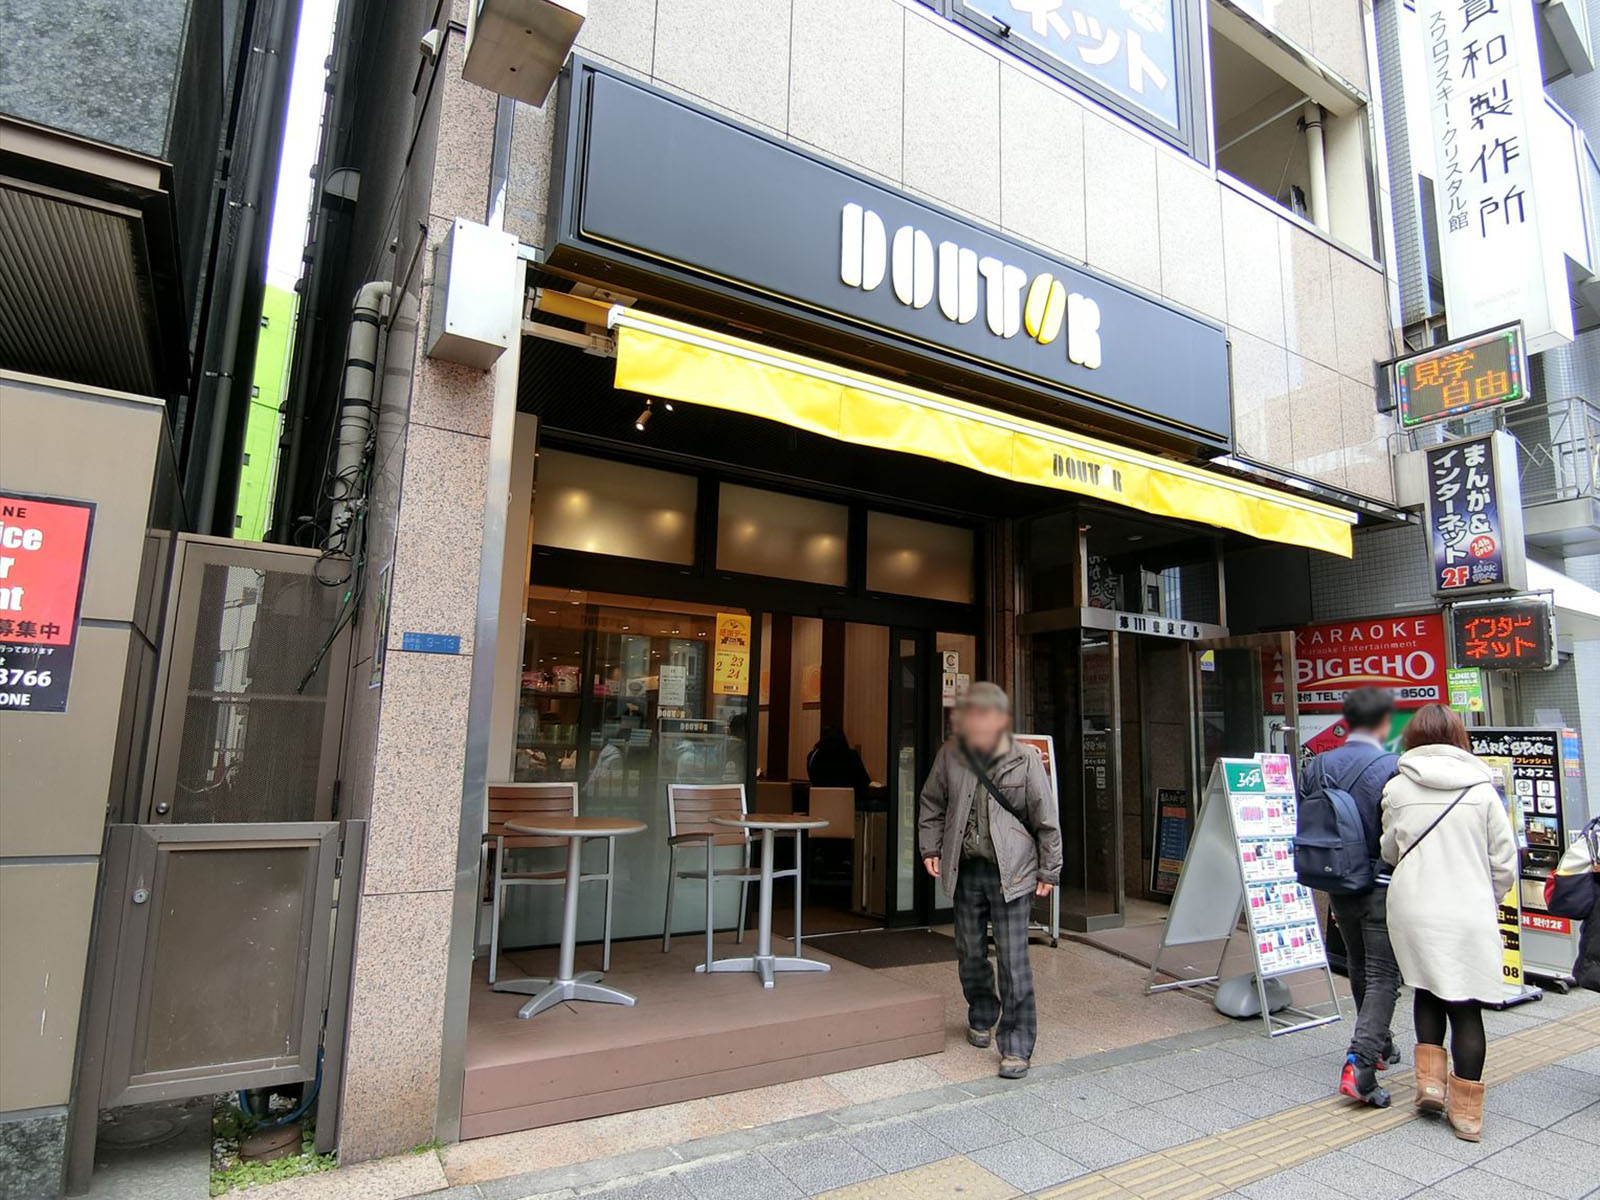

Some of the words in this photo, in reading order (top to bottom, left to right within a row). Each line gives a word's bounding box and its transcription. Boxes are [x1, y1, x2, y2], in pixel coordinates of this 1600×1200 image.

[840, 201, 1102, 370] DOUTOR
[1412, 350, 1476, 391] 見学
[1442, 371, 1509, 408] 自由
[1463, 444, 1493, 535] まんが&
[1432, 449, 1469, 565] インターネット
[1441, 565, 1470, 589] 2F
[1295, 620, 1427, 646] KARAOKE
[1342, 639, 1417, 653] Entertainment
[1465, 636, 1536, 660] ネット
[715, 660, 723, 672] 2
[727, 668, 742, 679] 24
[729, 656, 745, 668] 23
[1296, 657, 1343, 684] BIG
[1349, 650, 1436, 680] ECHO
